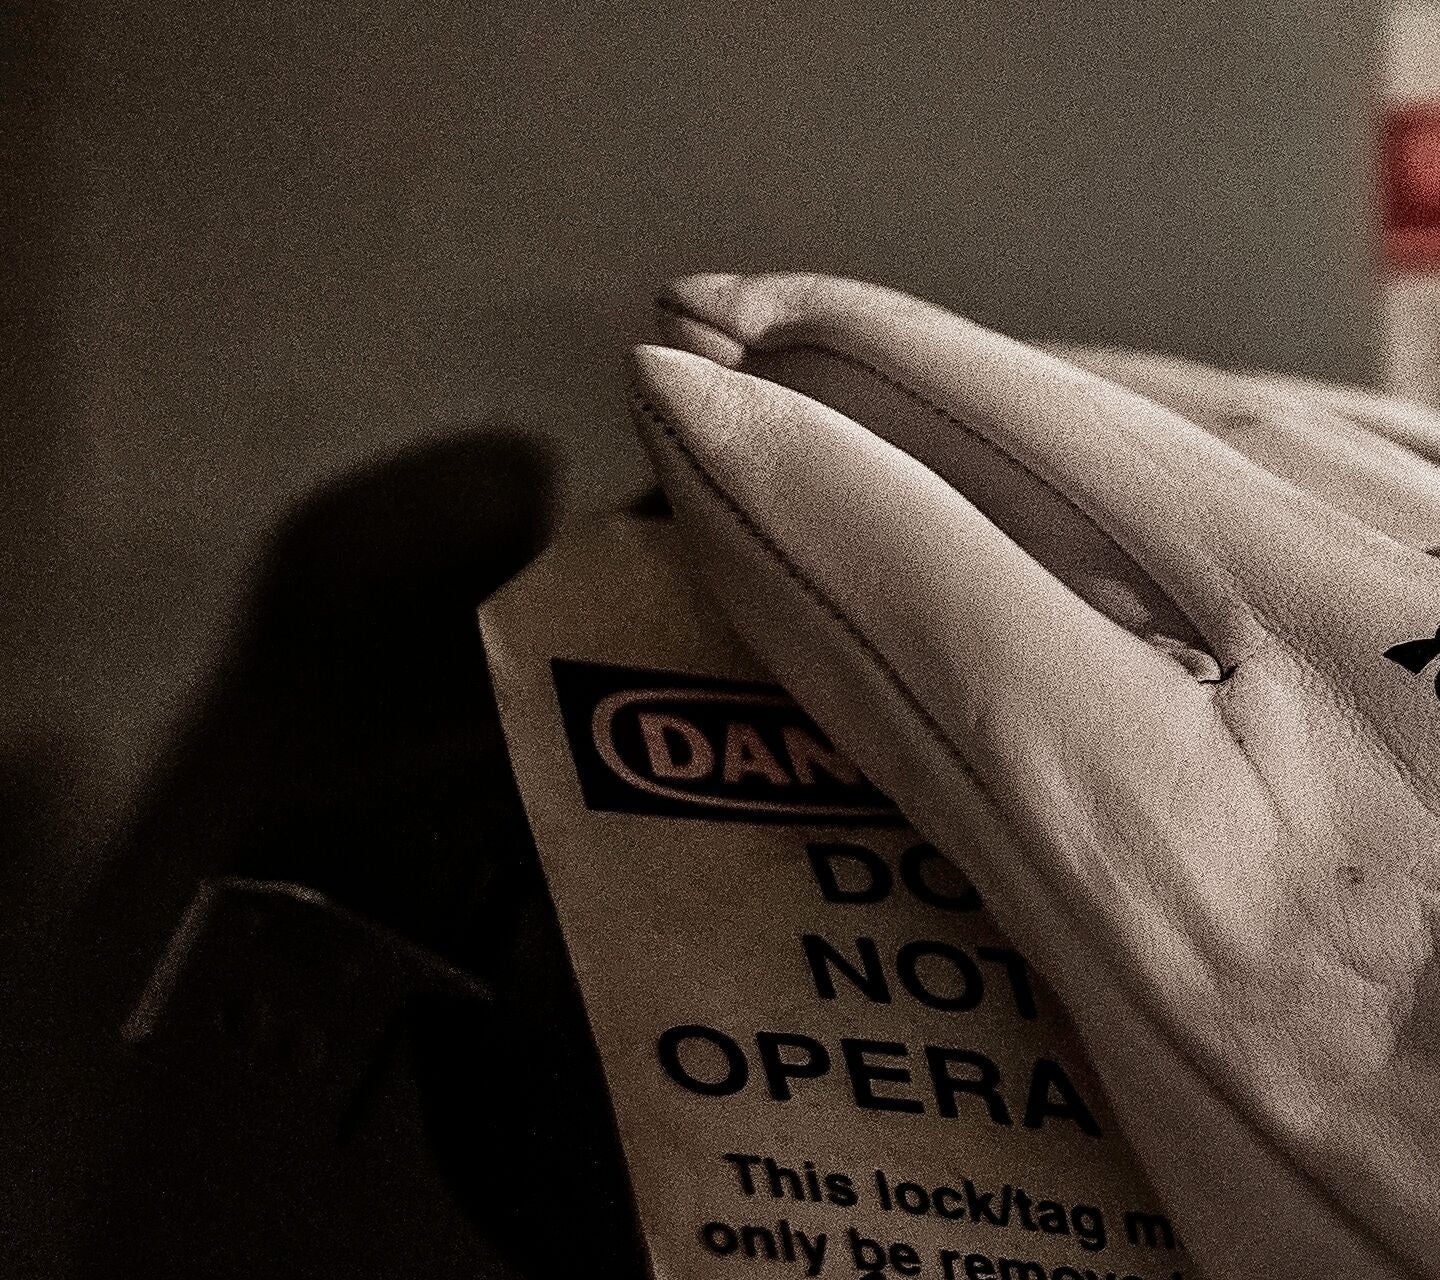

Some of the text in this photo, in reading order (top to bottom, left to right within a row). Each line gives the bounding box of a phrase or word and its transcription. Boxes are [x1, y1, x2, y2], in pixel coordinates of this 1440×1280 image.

[635, 711, 866, 790] DAN
[806, 842, 984, 913] DO
[802, 934, 1038, 1020] NOT
[658, 1025, 1104, 1138] OPERA
[724, 1153, 858, 1208] This
[876, 1169, 1107, 1251] lock/tag
[702, 1220, 828, 1277] only
[848, 1227, 922, 1276] be
